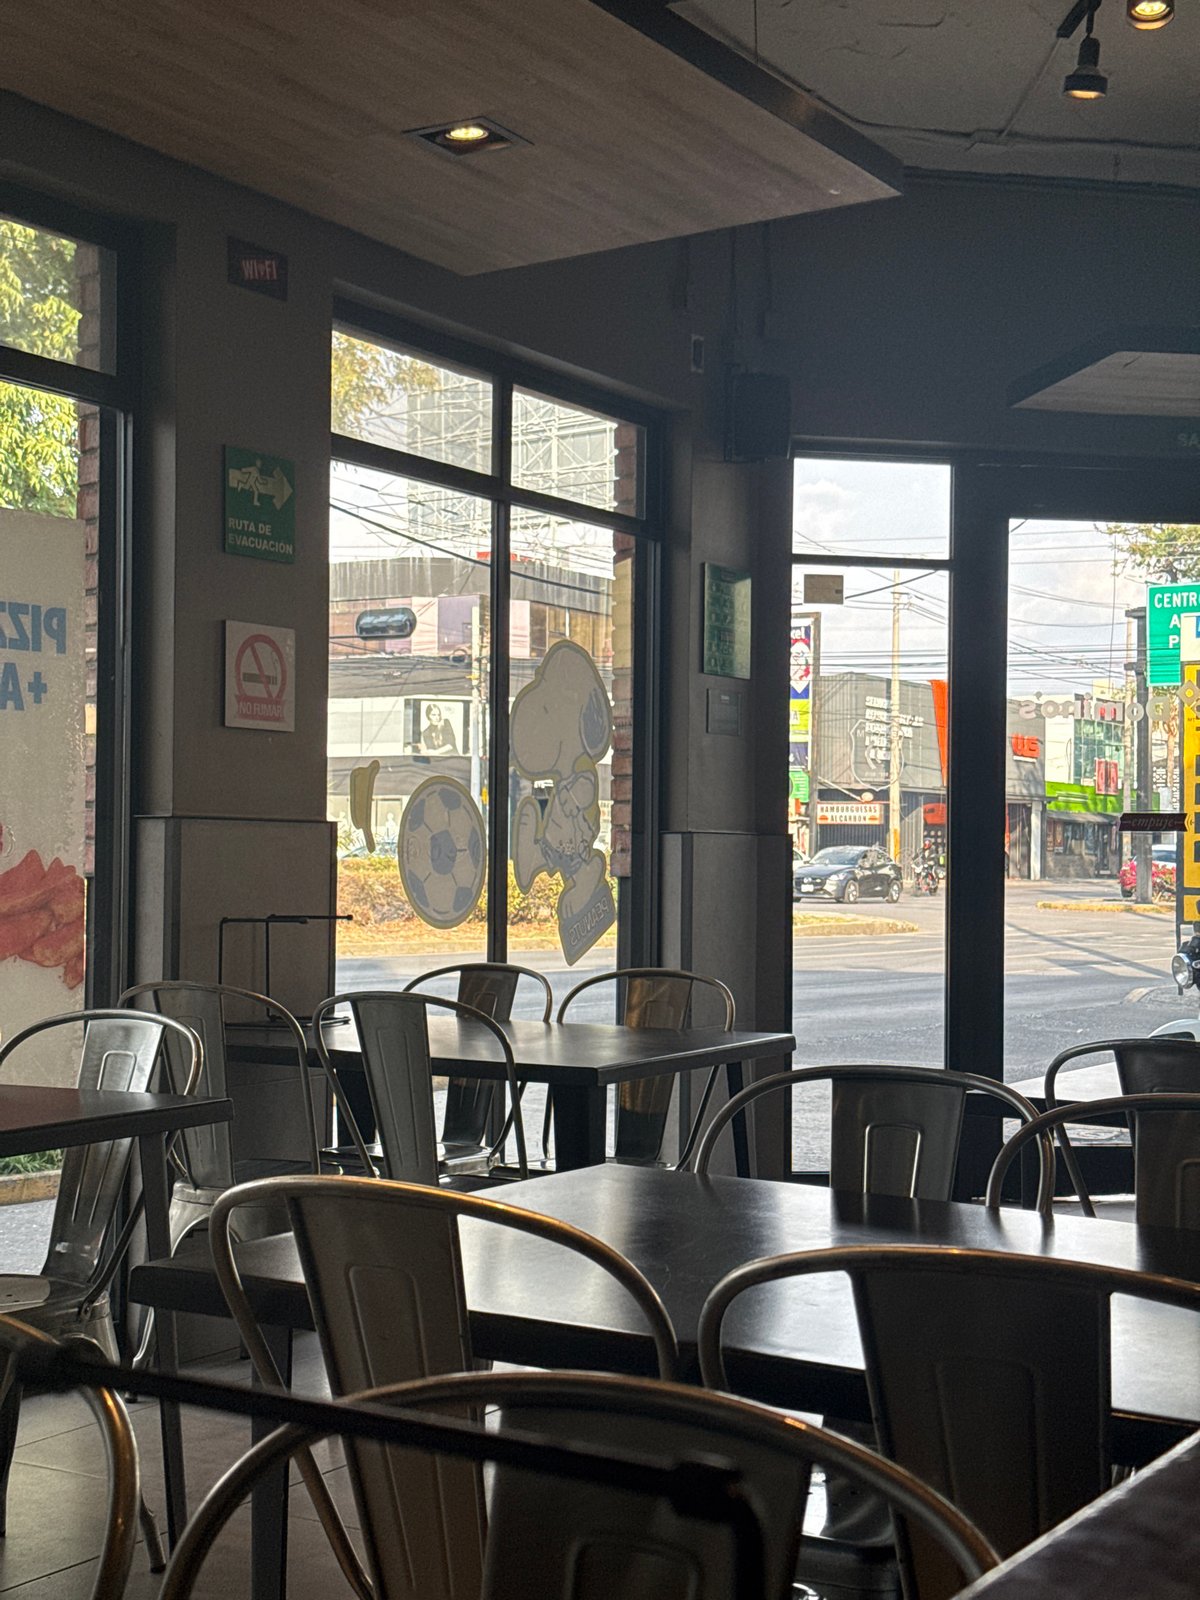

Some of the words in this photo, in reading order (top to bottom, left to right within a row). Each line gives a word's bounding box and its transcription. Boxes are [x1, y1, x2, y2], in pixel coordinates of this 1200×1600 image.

[228, 517, 256, 533] RUTA
[258, 523, 272, 536] DE
[1154, 592, 1200, 608] CENTR
[239, 701, 252, 715] NO
[253, 703, 283, 718] FUMAR
[820, 805, 877, 813] HAMBURGUESAS
[1131, 817, 1174, 830] empuje
